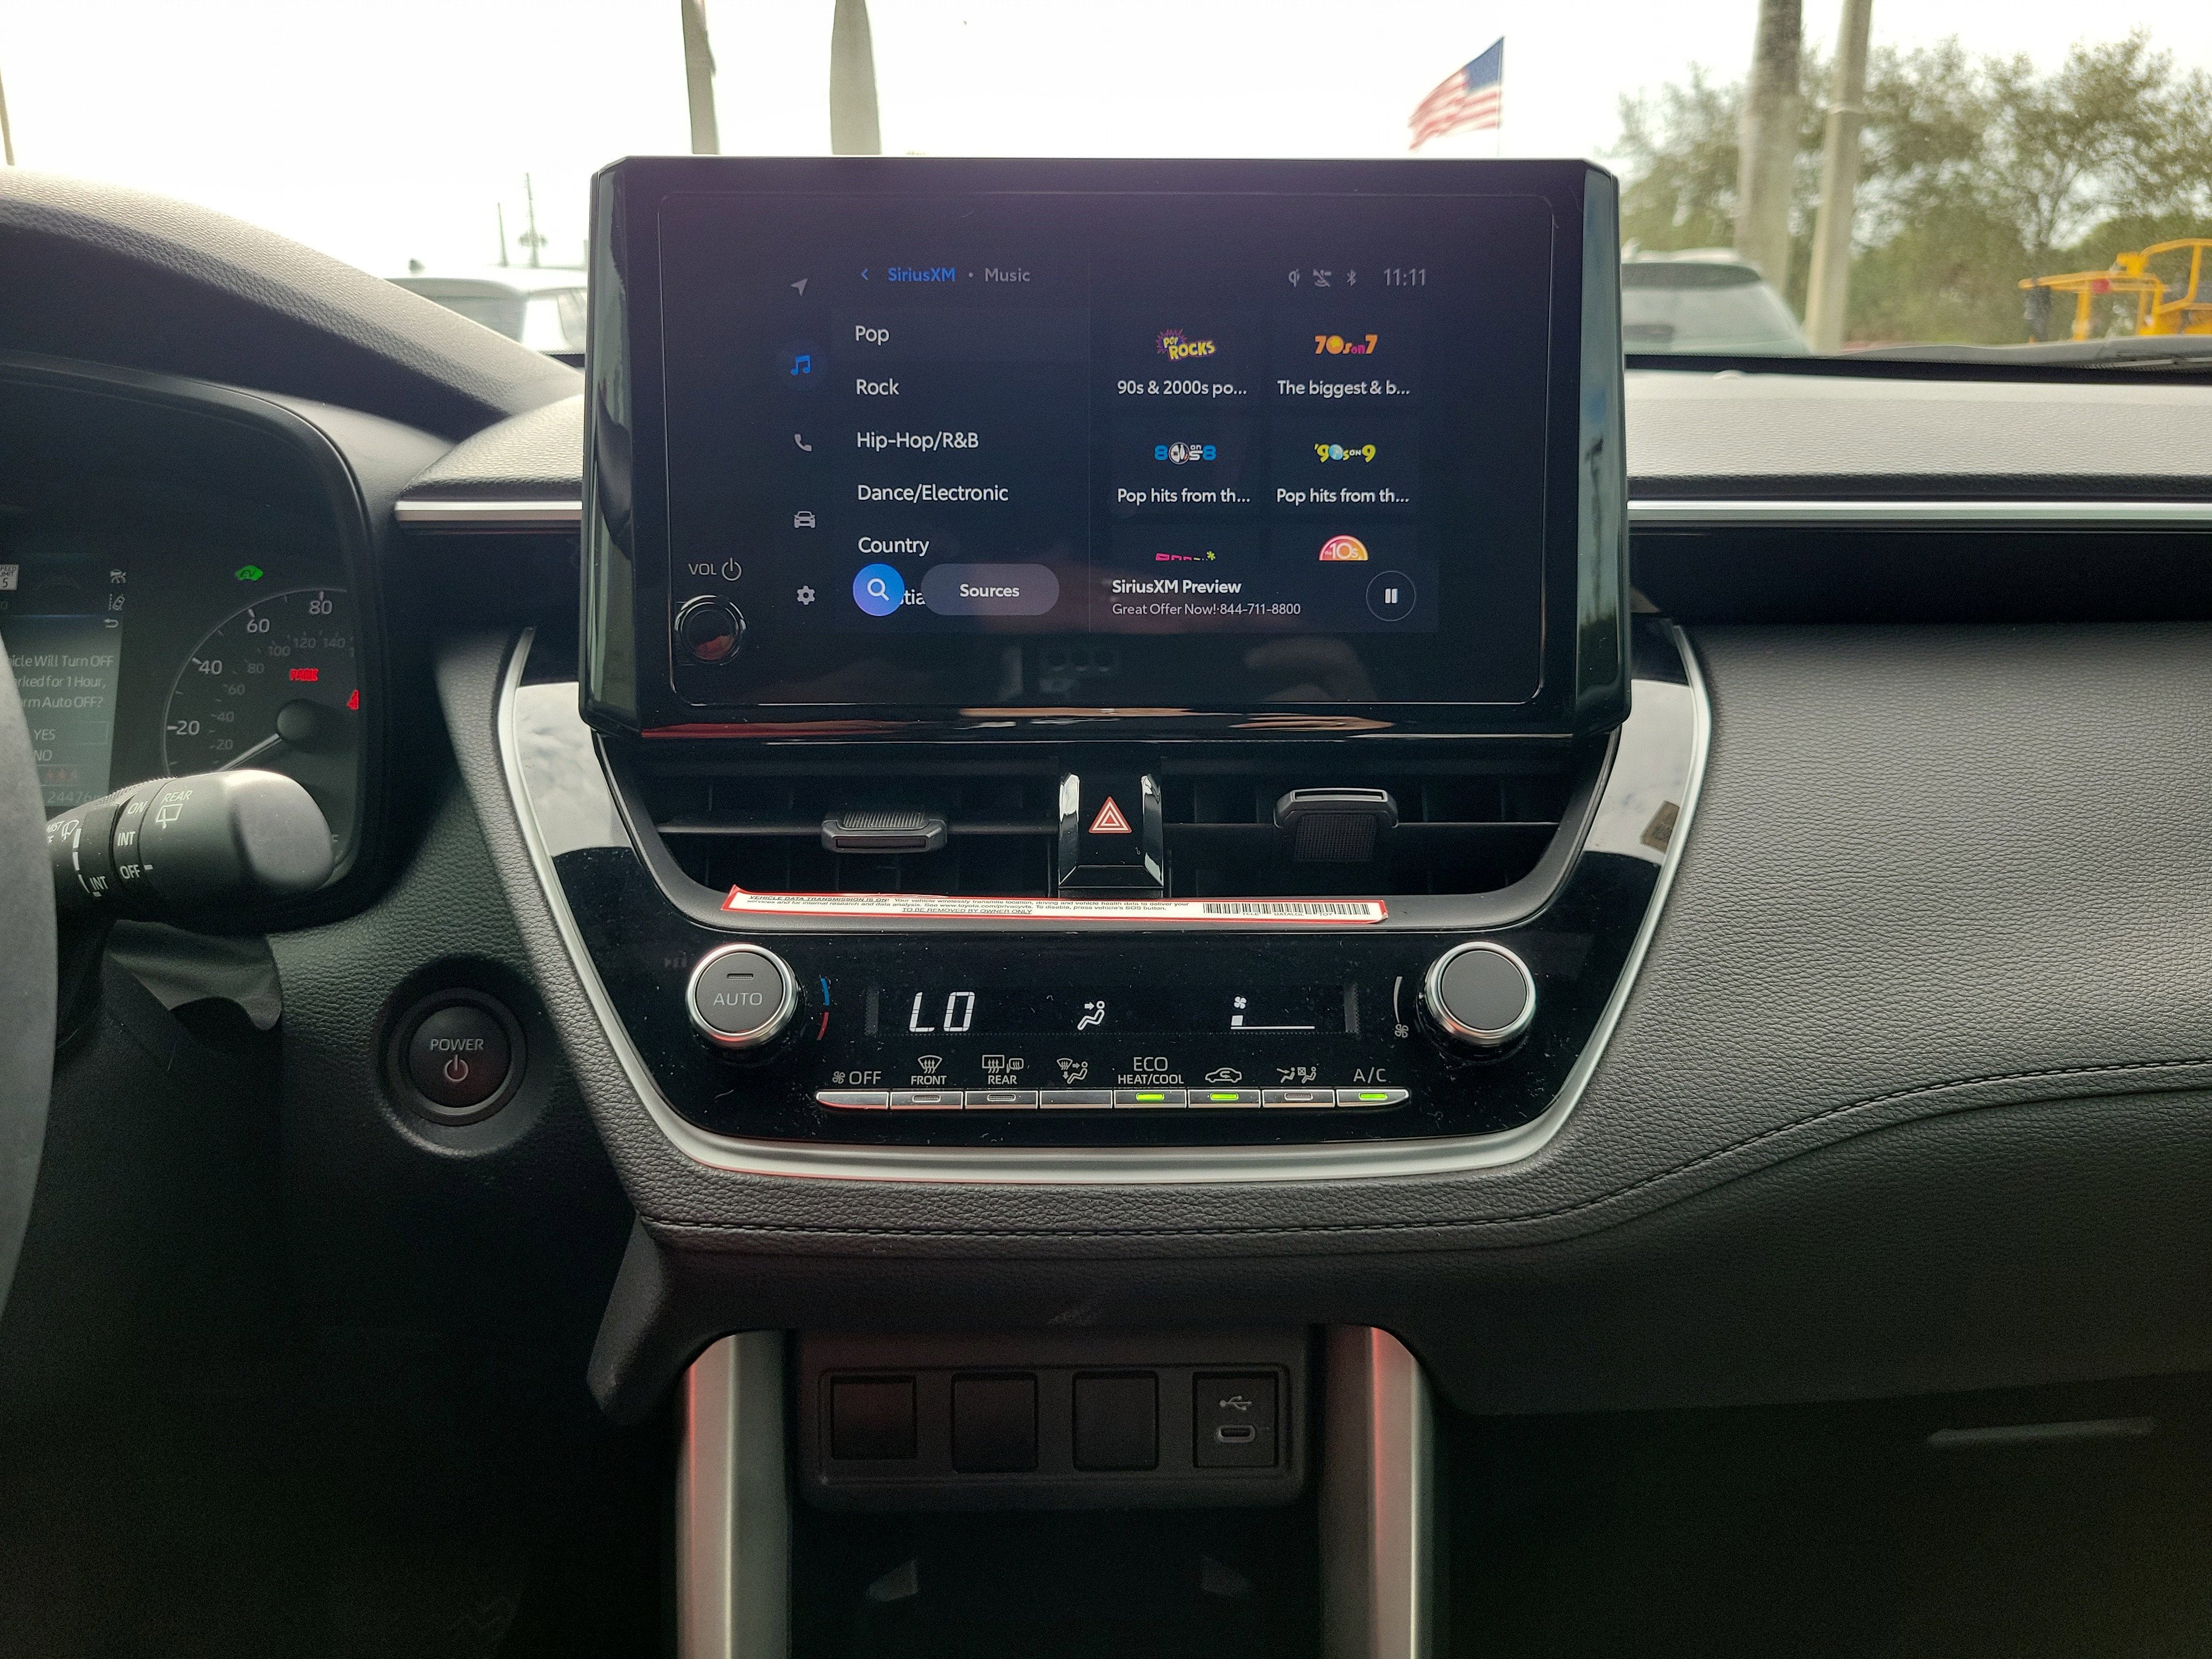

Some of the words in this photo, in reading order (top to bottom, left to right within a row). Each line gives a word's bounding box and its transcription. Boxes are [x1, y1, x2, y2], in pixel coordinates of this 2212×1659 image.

[888, 268, 956, 283] SiriusXM
[985, 268, 1030, 283] Music
[1383, 268, 1425, 286] 11:11
[855, 326, 889, 345] Pop
[1163, 336, 1178, 348] POP
[1169, 340, 1216, 361] ROCKS
[856, 379, 900, 396] Rock
[1117, 381, 1144, 396] 90s
[1147, 381, 1160, 396] &
[1163, 381, 1209, 396] 2000s
[1277, 380, 1306, 395] The
[1309, 380, 1368, 398] biggest
[1369, 381, 1383, 396] &
[857, 432, 979, 452] Hip-Hop/R&B
[857, 484, 1009, 504] Dance/Electronic
[1118, 488, 1147, 506] Pop
[1151, 488, 1178, 503] hits
[1181, 488, 1216, 503] from
[1277, 488, 1306, 506] Pop
[1310, 488, 1336, 503] hits
[1340, 488, 1375, 503] from
[858, 537, 929, 556] Country
[688, 563, 717, 575] VOL
[960, 584, 1020, 597] Sources
[1111, 579, 1179, 595] SiriusXM
[1182, 579, 1242, 595] Preview
[309, 600, 332, 614] 80
[1112, 603, 1148, 615] Great
[1149, 603, 1182, 615] Offer
[247, 619, 270, 633] 60
[294, 638, 317, 648] 120
[324, 637, 346, 648] 140
[268, 646, 291, 657] 100
[35, 654, 59, 667] Will
[62, 655, 88, 667] Turn
[91, 655, 114, 667] OFF
[199, 661, 223, 675] 40
[248, 663, 264, 673] 80
[46, 675, 65, 687] for
[66, 676, 72, 687] 1
[75, 675, 106, 689] Hour,
[229, 684, 246, 695] 60
[42, 696, 72, 708] Auto
[74, 696, 104, 708] OFF?
[217, 712, 235, 722] 40
[177, 720, 200, 735] 20
[33, 729, 57, 741] YES
[216, 739, 233, 750] 20
[34, 749, 53, 761] NO
[161, 790, 193, 804] REAR
[127, 800, 148, 815] ON
[117, 831, 136, 847] INT
[120, 864, 140, 879] OFF
[89, 876, 109, 890] INT
[713, 992, 763, 1006] AUTO
[429, 1039, 484, 1051] POWER
[1132, 1056, 1169, 1072] ECO
[849, 1071, 882, 1085] OFF
[911, 1075, 947, 1085] FRONT
[988, 1074, 1017, 1085] REAR
[1118, 1074, 1184, 1085] HEAT/COOL
[1353, 1068, 1386, 1083] A/C
